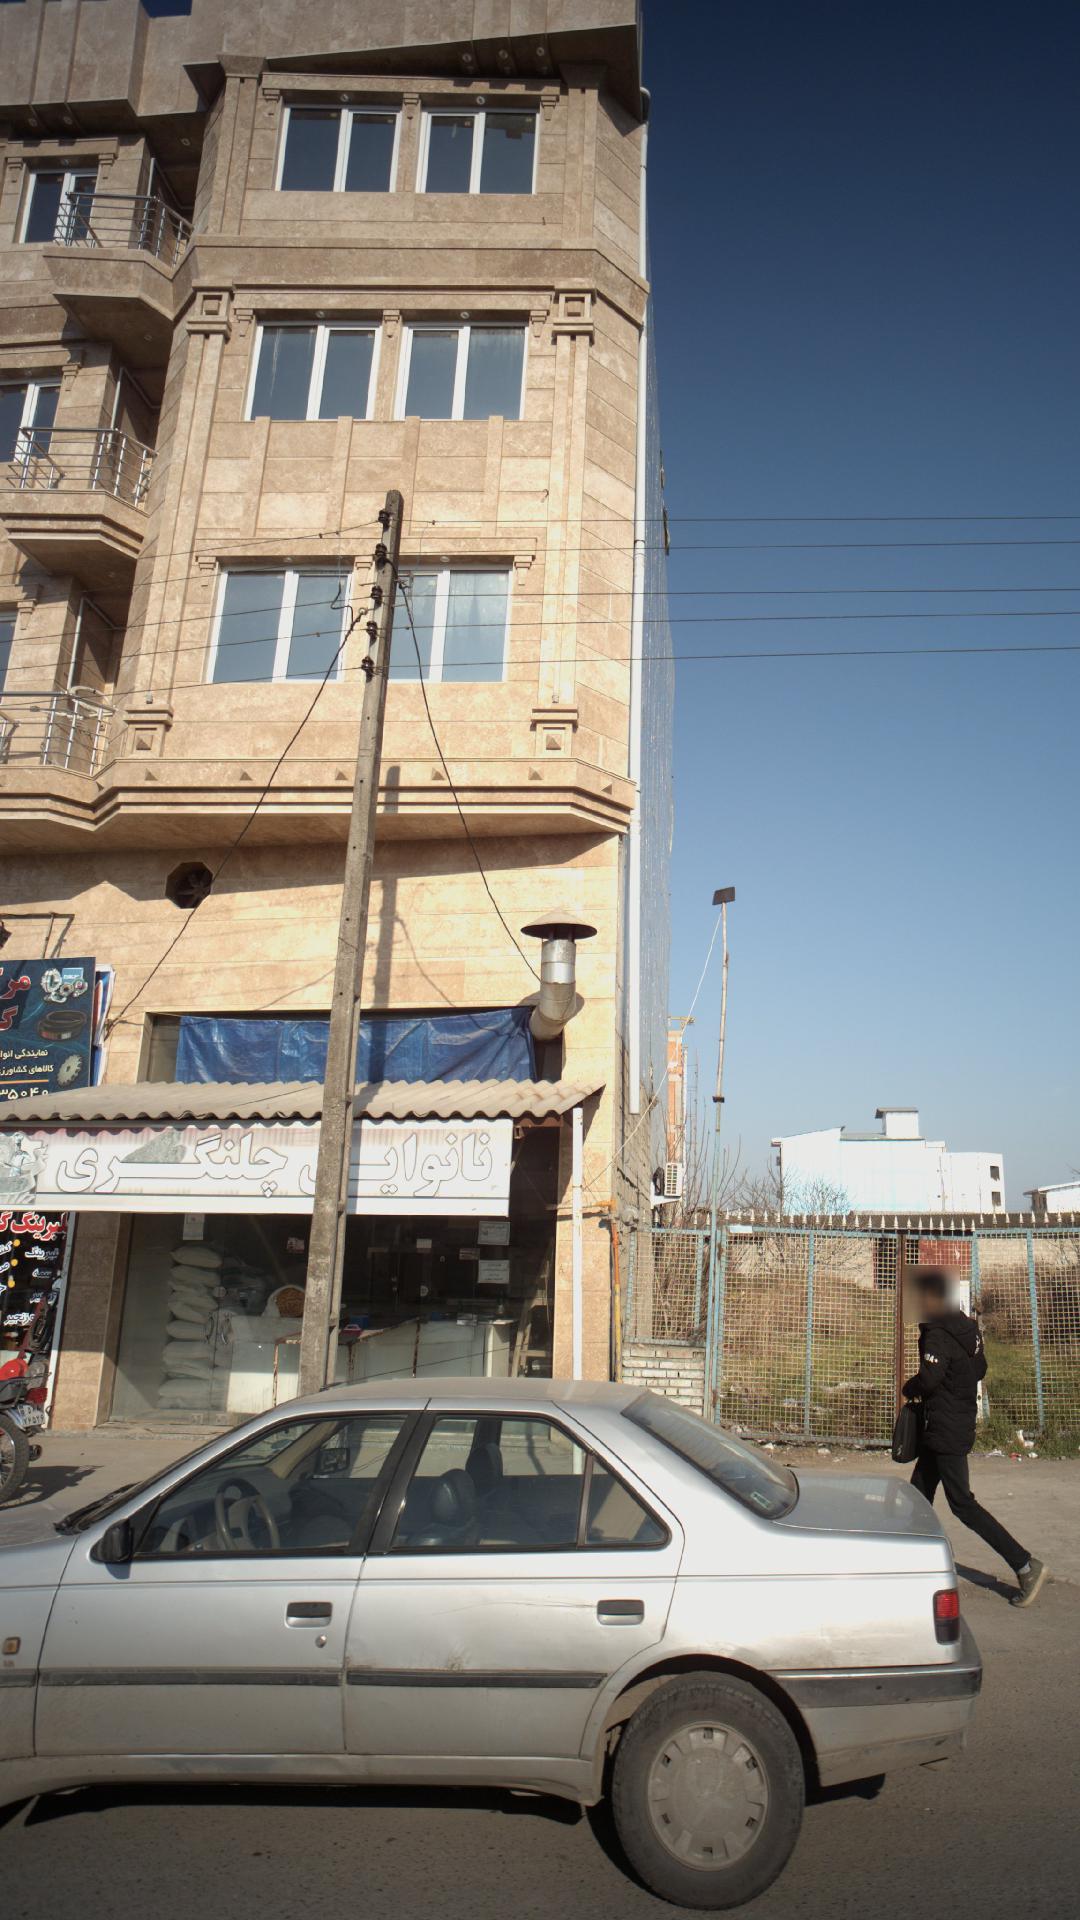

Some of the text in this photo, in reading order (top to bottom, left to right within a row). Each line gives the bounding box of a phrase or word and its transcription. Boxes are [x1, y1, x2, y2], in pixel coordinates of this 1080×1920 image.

[0, 1049, 48, 1060] نمایندگی انوا
[0, 1064, 54, 1076] کالاهای کشاورز
[56, 1132, 288, 1198] چلنگری
